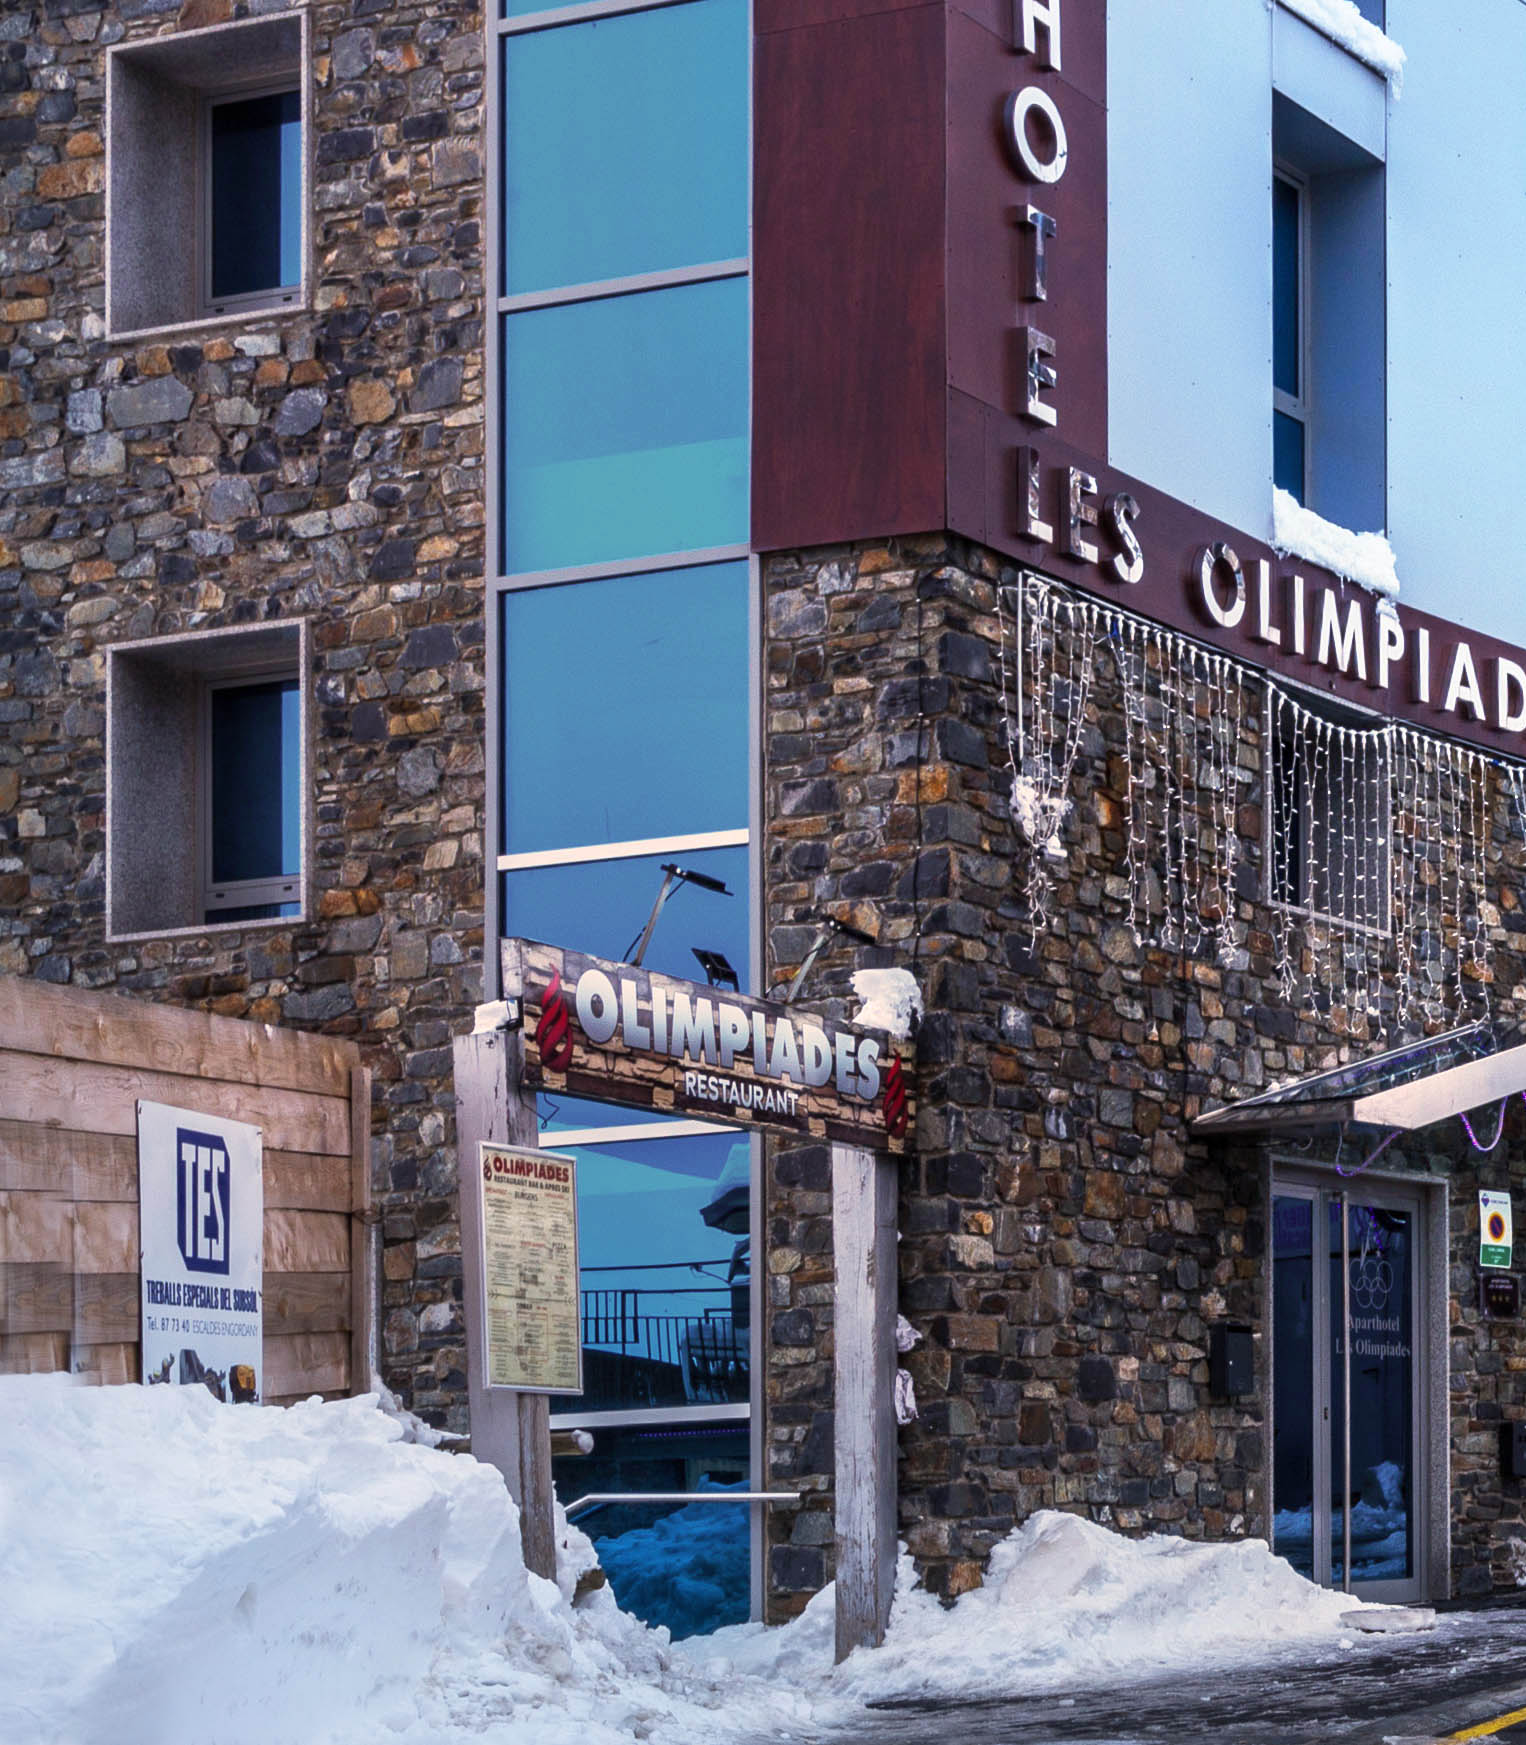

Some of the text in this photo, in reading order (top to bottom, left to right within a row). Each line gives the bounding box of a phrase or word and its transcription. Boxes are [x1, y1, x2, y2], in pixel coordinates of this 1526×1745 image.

[1017, 444, 1145, 585] LES
[575, 968, 880, 1100] OLIMPIADES
[685, 1072, 799, 1117] RESTAURANT
[493, 1156, 570, 1184] OLIMPIADES
[181, 1141, 225, 1262] TES
[146, 1279, 182, 1306] TREBALLS
[182, 1283, 219, 1310] ESPECIALS
[220, 1287, 232, 1311] DEL
[147, 1316, 159, 1331] Tel.
[161, 1317, 170, 1332] 87
[1335, 1338, 1411, 1361] Ls Olimpiades
